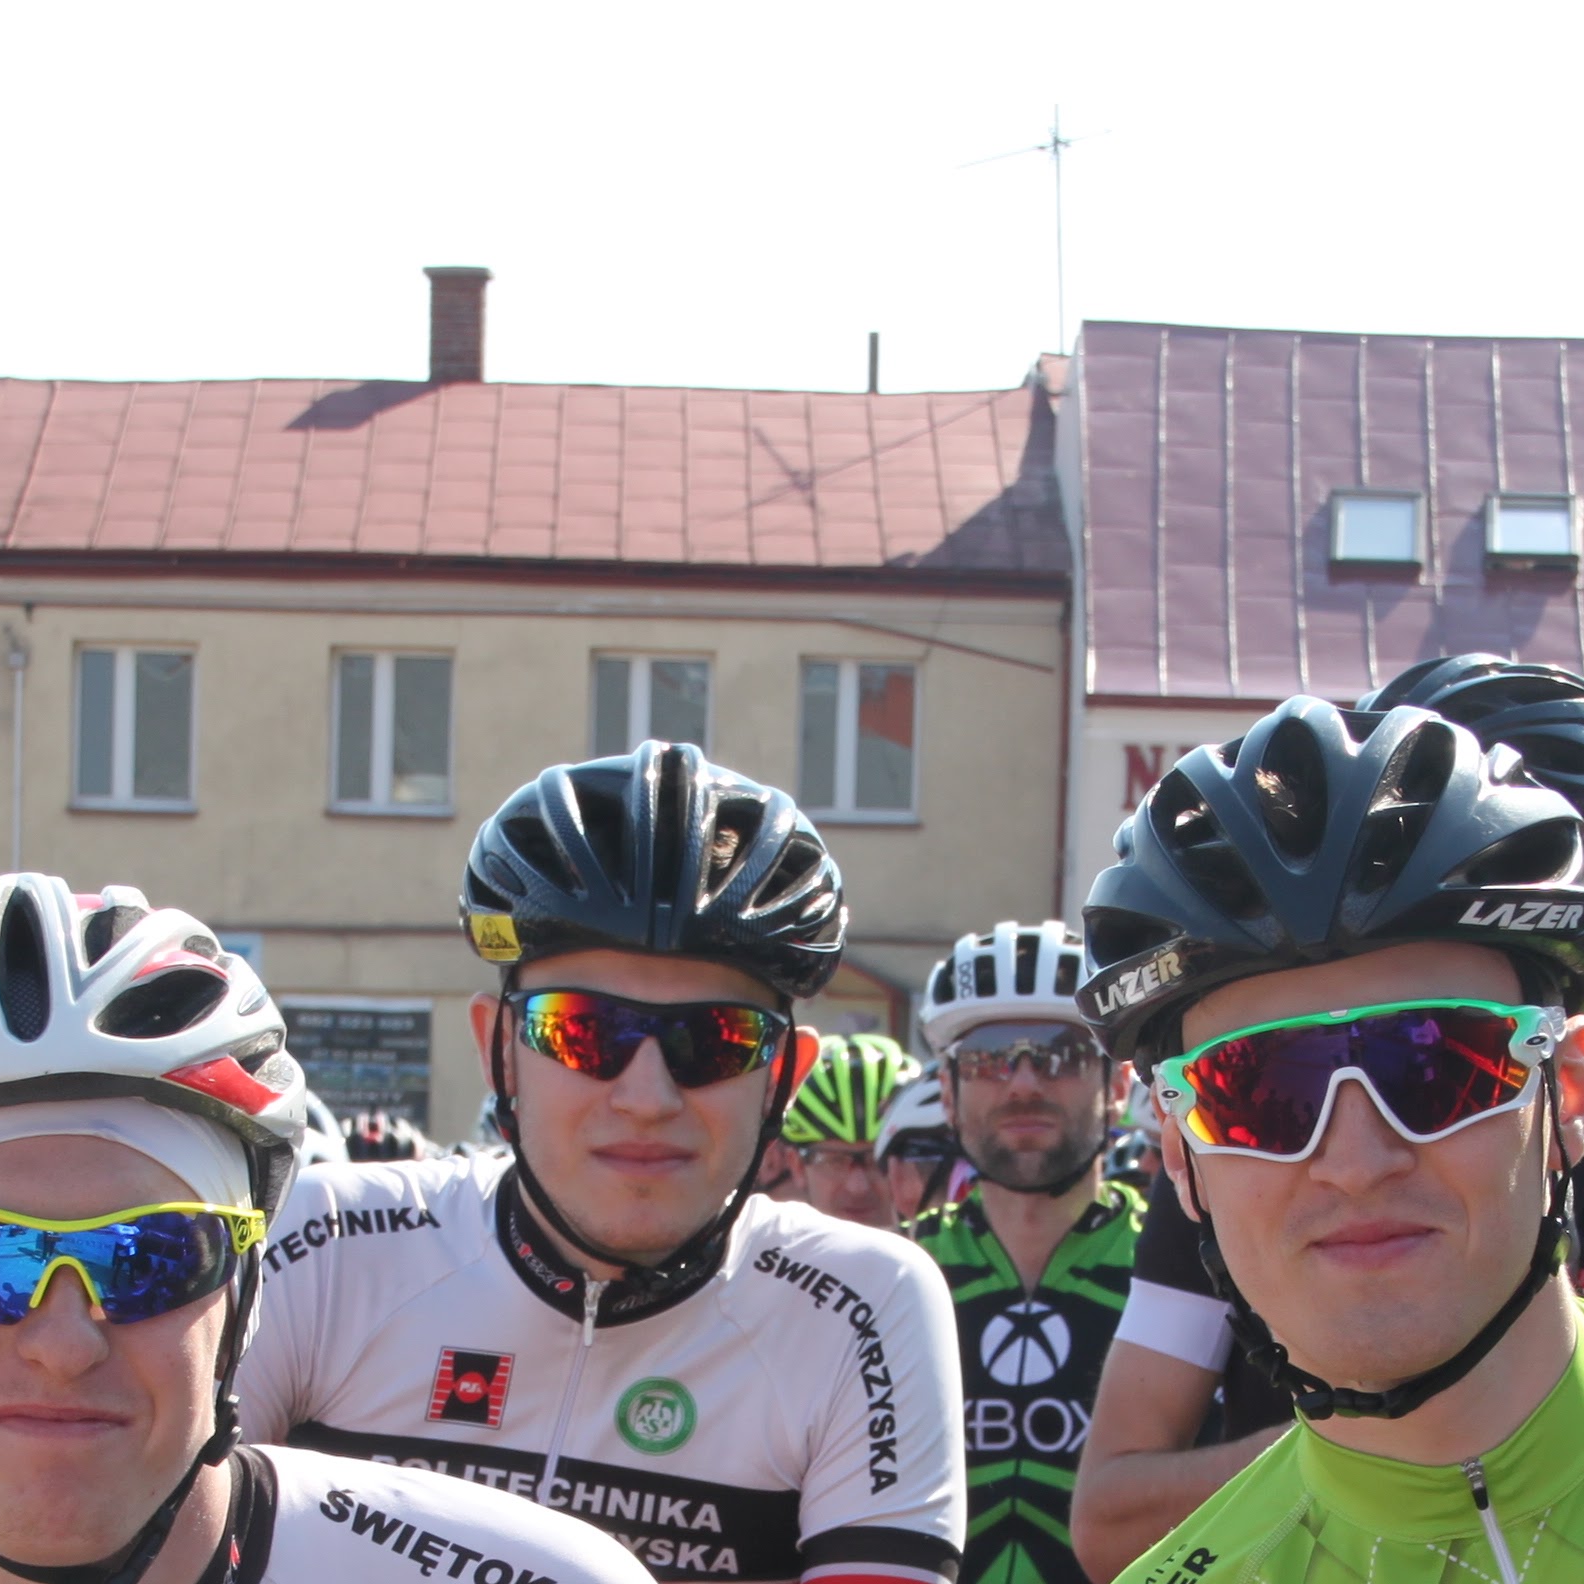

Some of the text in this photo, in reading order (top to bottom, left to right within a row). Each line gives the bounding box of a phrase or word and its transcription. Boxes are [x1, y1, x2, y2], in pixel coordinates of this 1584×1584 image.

[1459, 898, 1584, 931] LAZER
[1095, 948, 1186, 1017] LAZER
[262, 1205, 441, 1279] TECHNIKA
